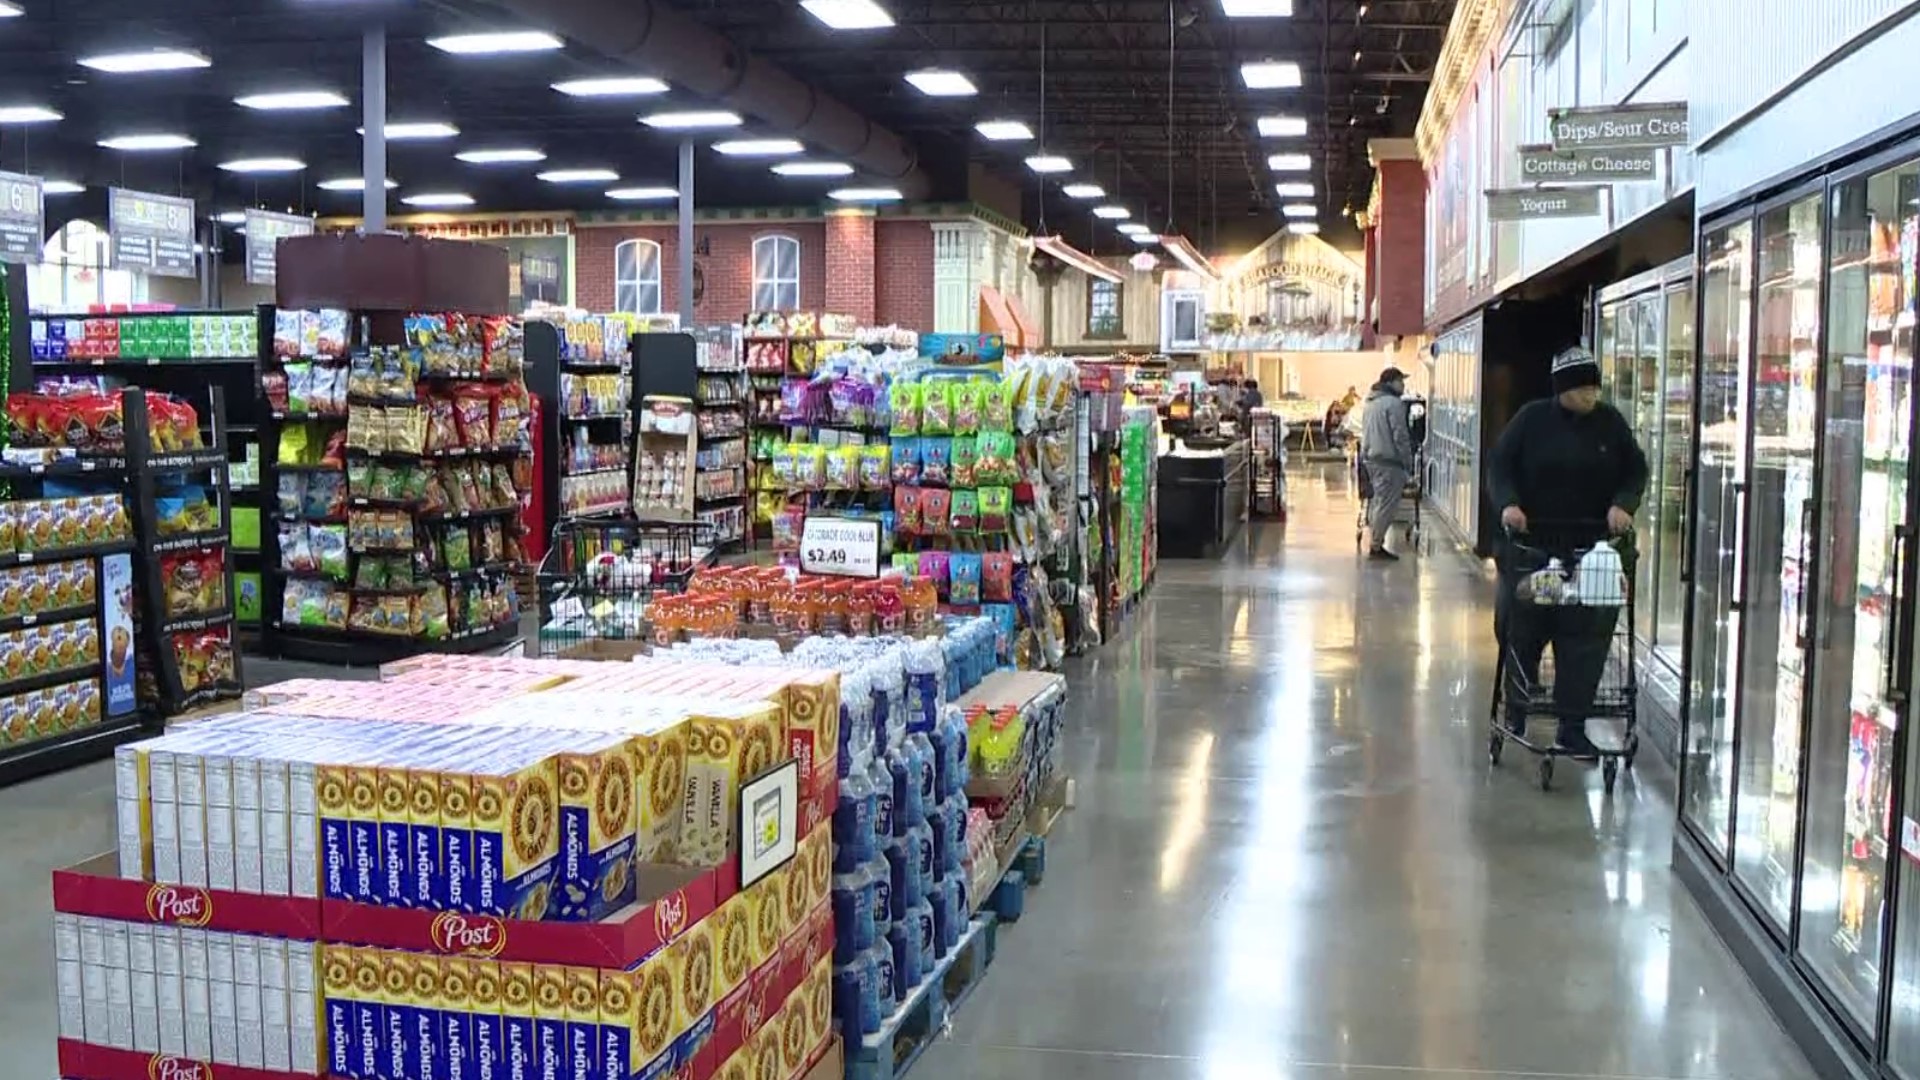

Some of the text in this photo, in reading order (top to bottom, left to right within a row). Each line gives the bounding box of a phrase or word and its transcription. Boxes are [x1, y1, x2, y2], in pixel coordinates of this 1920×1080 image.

[1524, 156, 1652, 175] Cottage Cheese
[1557, 120, 1643, 144] Dips/Sour
[11, 182, 22, 212] 6
[1520, 198, 1568, 214] Yogurt
[807, 548, 847, 564] $2.49
[326, 824, 342, 894] ALMONDS
[355, 826, 371, 897] ALMONDS
[385, 828, 400, 898] ALMONDS
[416, 831, 431, 901] ALMONDS
[448, 834, 463, 905] ALMONDS
[480, 836, 494, 909] ALMONDS
[567, 812, 579, 880] ALMONDS
[158, 888, 202, 919] Post
[443, 918, 494, 947] Post
[659, 896, 682, 938] Post
[158, 1056, 203, 1080] Post
[332, 1004, 347, 1073] ALMONDS
[361, 1008, 375, 1076] ALMONDS
[390, 1009, 404, 1078] ALMONDS
[418, 1013, 432, 1080] ALMONDS
